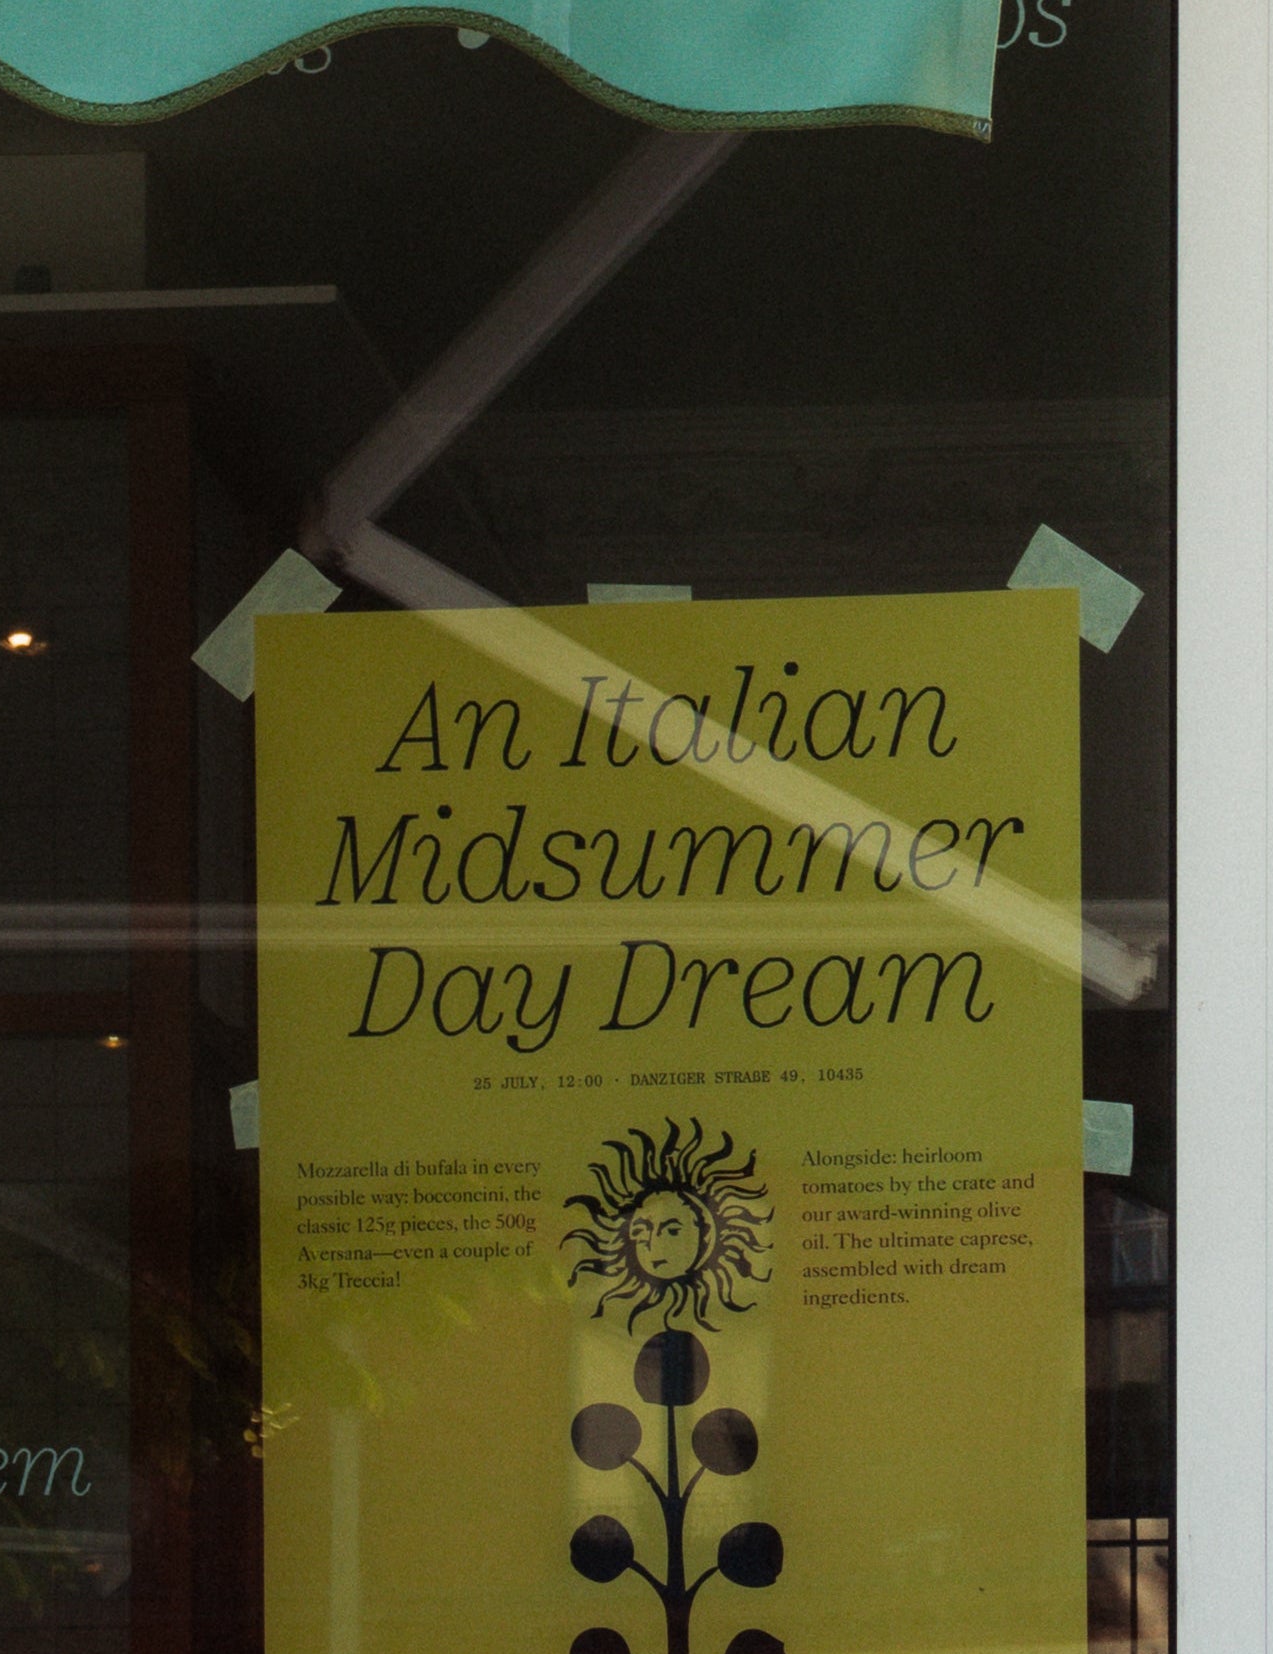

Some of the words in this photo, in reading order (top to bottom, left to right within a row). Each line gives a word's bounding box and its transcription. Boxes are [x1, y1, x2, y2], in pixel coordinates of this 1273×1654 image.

[376, 681, 531, 772] An
[560, 662, 957, 767] Italian
[316, 806, 1024, 905] Midsummer
[348, 947, 571, 1053] Day
[599, 941, 994, 1030] Dream
[474, 1078, 491, 1090] 25
[501, 1076, 545, 1090] JULY,
[559, 1075, 602, 1088] 12:00
[631, 1073, 705, 1086] DANZIGER
[781, 1070, 805, 1082] 49,
[819, 1068, 863, 1081] 10435
[298, 1162, 388, 1178] Mozzarella
[394, 1161, 409, 1176] di
[416, 1160, 466, 1175] bufala
[473, 1159, 488, 1174] in
[494, 1163, 540, 1176] every
[802, 1149, 896, 1168] Alongside:
[903, 1148, 982, 1163] heirloom
[803, 1182, 884, 1194] tomatoes
[890, 1177, 911, 1196] by
[918, 1176, 946, 1191] the
[953, 1179, 995, 1190] crate
[1002, 1173, 1034, 1189] and
[297, 1190, 365, 1211] possible
[371, 1193, 408, 1208] way:
[414, 1188, 508, 1203] bocconcini,
[515, 1186, 541, 1201] the
[802, 1211, 831, 1221] our
[838, 1203, 972, 1221] award-winning
[978, 1202, 1020, 1217] olive
[297, 1219, 350, 1234] classic
[358, 1217, 395, 1234] 125g
[401, 1216, 457, 1235] pieces,
[463, 1215, 490, 1230] the
[496, 1214, 536, 1232] 500g
[440, 1248, 448, 1258] a
[453, 1242, 509, 1261] couple
[515, 1241, 533, 1256] of
[802, 1234, 829, 1250] oil.
[834, 1233, 872, 1249] The
[879, 1233, 954, 1247] ultimate
[960, 1234, 1033, 1249] caprese,
[803, 1260, 897, 1277] assembled
[904, 1259, 942, 1274] with
[950, 1258, 1006, 1274] dream
[298, 1274, 328, 1292] 3kg
[333, 1271, 400, 1288] Treccia!
[804, 1289, 909, 1308] ingredients.
